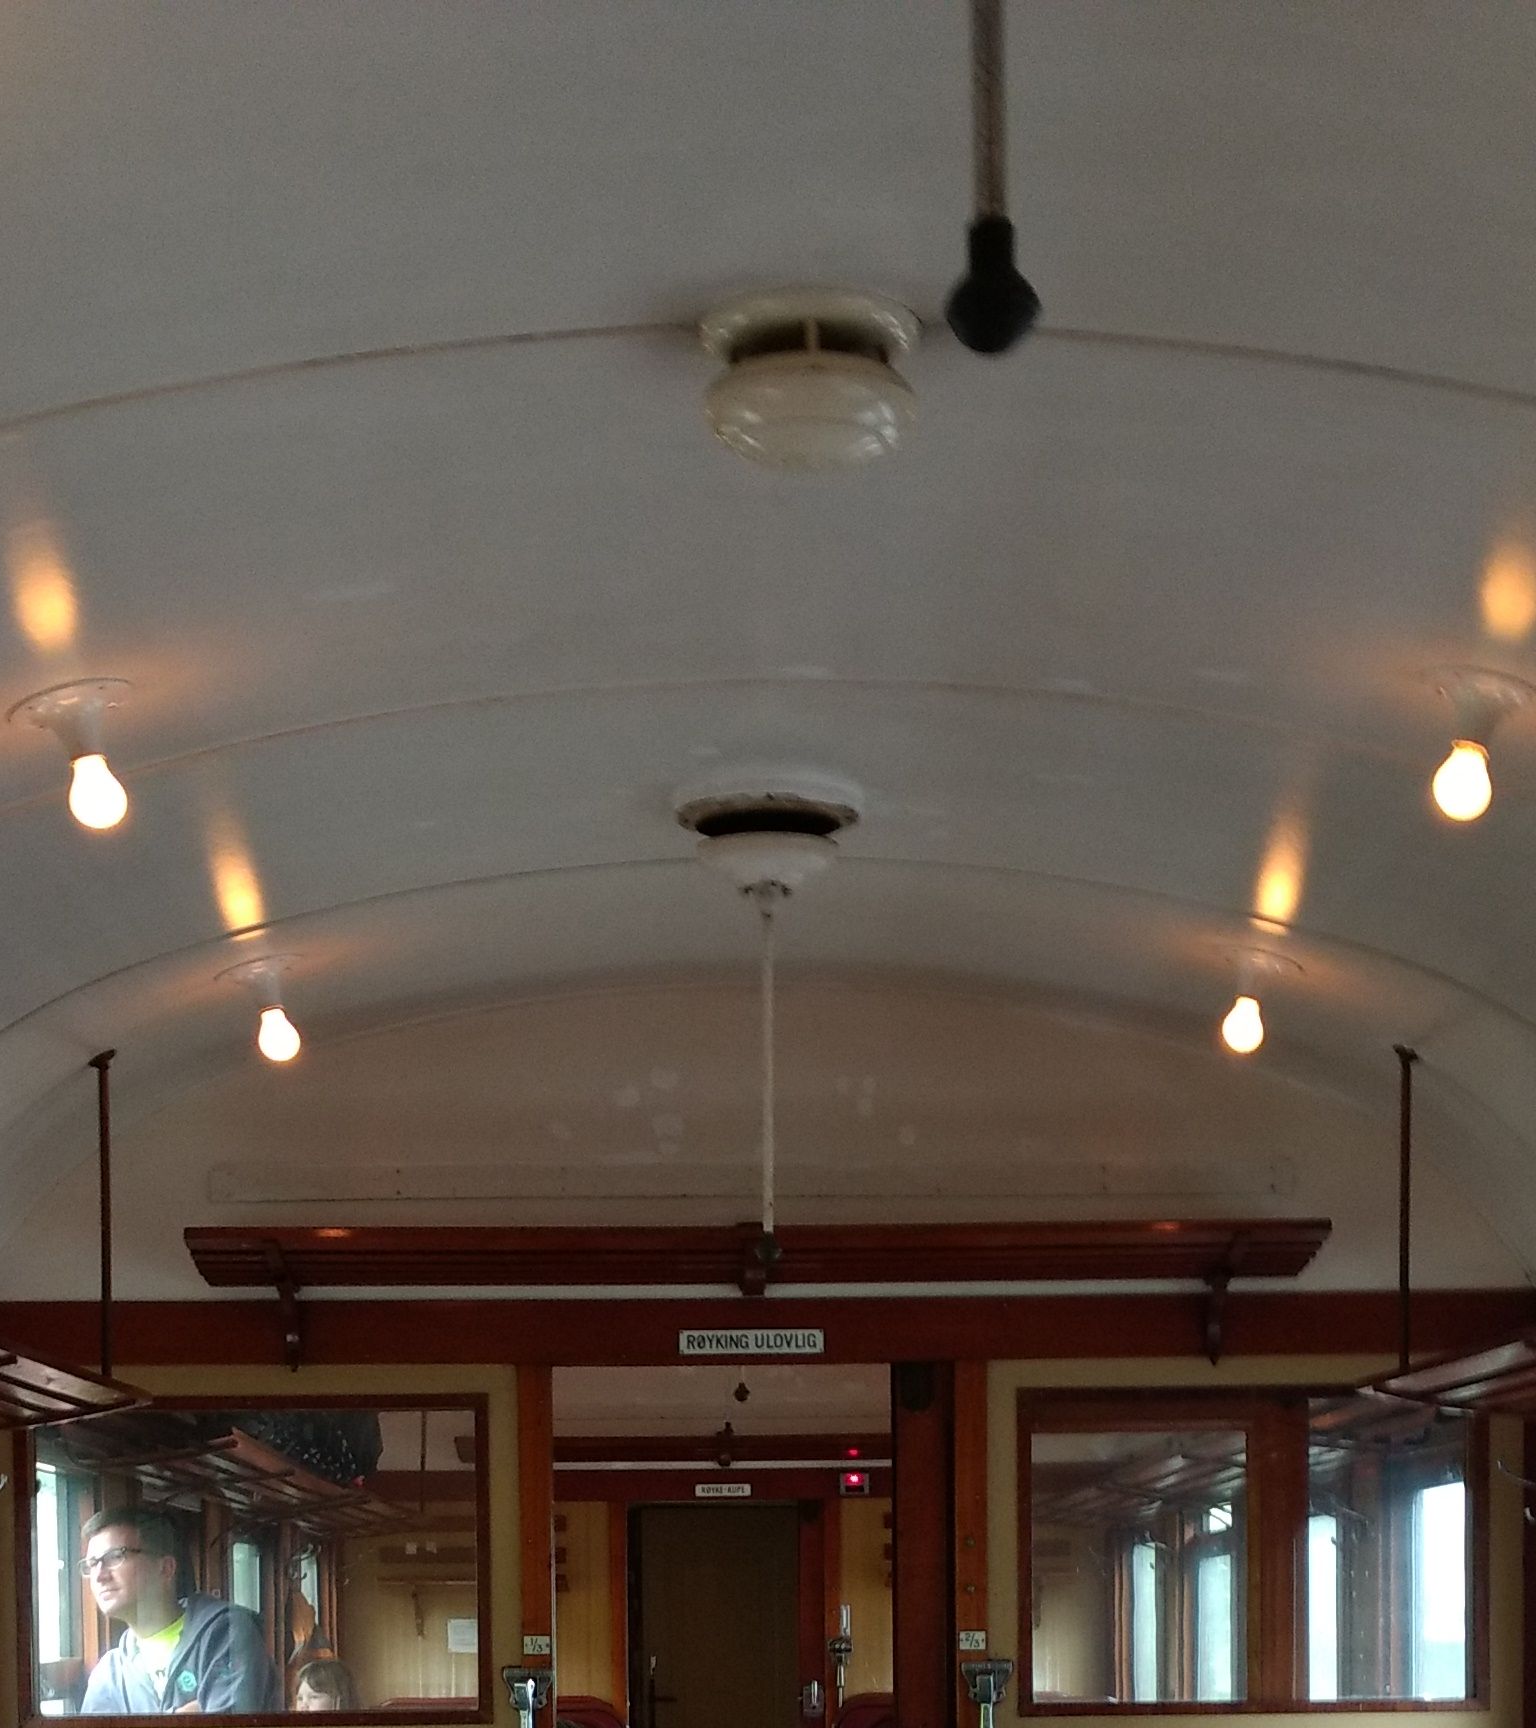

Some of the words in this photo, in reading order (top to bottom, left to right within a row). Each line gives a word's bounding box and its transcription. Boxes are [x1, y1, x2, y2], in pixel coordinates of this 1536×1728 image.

[686, 1334, 749, 1349] RØYKING
[755, 1333, 817, 1348] ULOVLIG
[530, 1637, 543, 1653] 1/3
[964, 1632, 980, 1648] 2/3
